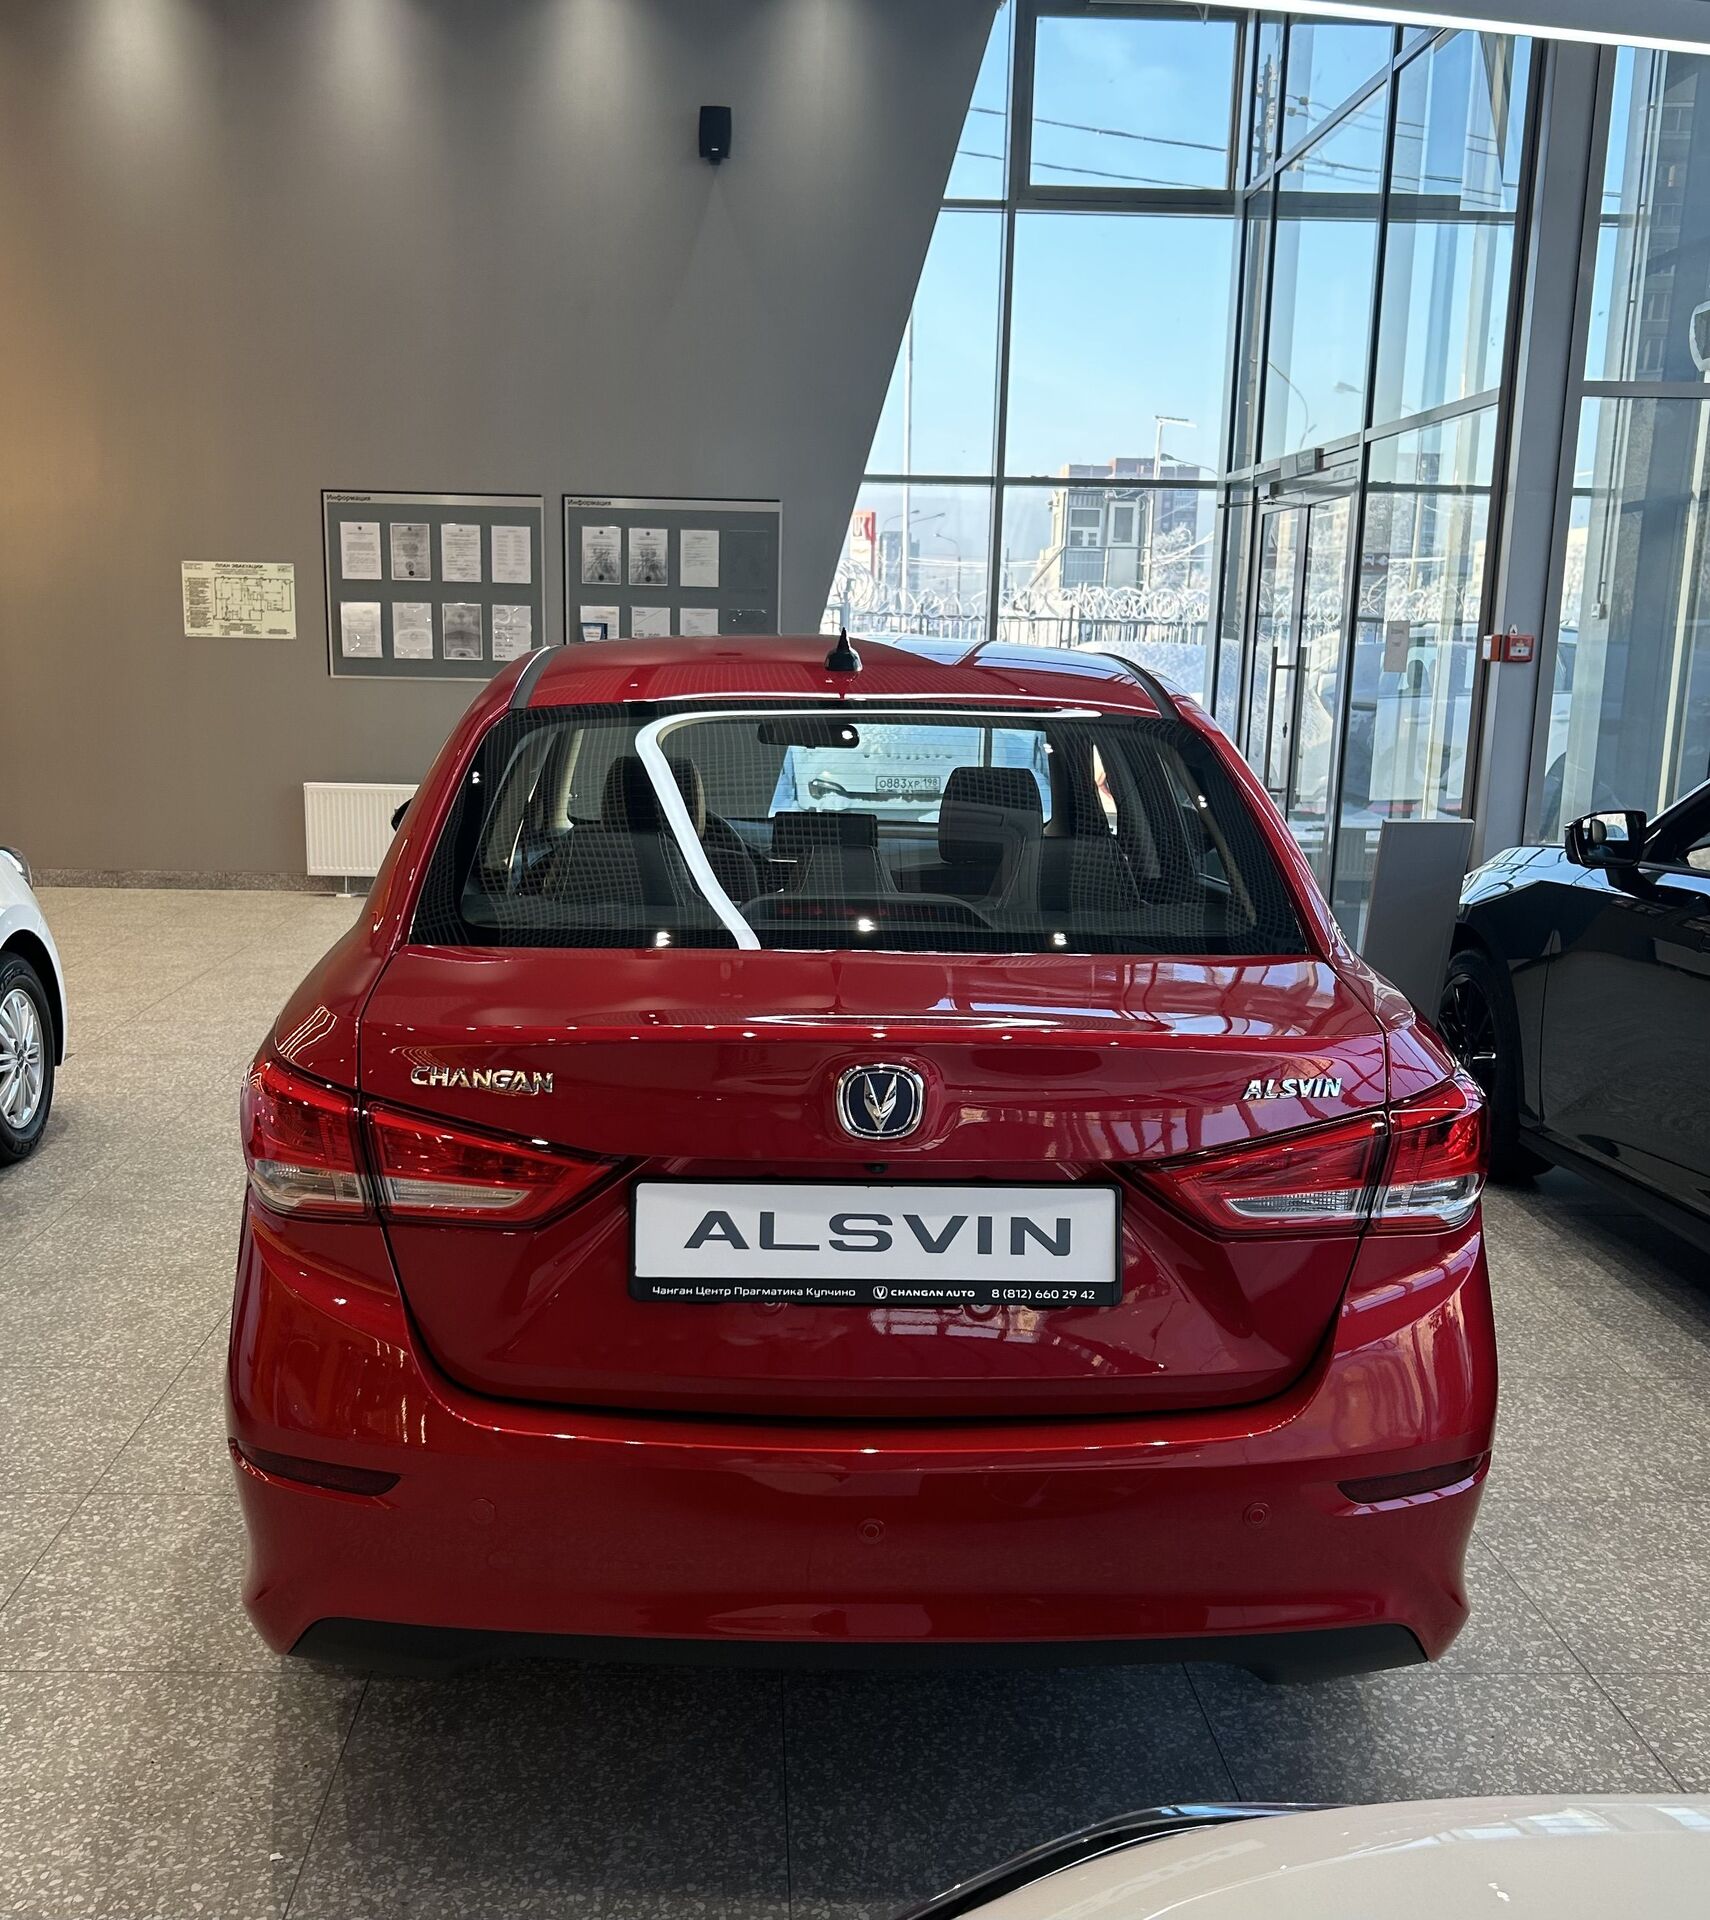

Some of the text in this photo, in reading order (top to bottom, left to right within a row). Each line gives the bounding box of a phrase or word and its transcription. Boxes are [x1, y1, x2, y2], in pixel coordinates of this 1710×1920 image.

[410, 1065, 554, 1094] CHANGAN
[1242, 1077, 1343, 1100] ALSVIN
[683, 1210, 1072, 1257] ALSVIN
[652, 1286, 856, 1298] Чанган Центр Прагматика Купчино
[890, 1288, 1096, 1300] CHANGAN AUTO 8 (812) 660 29 42
